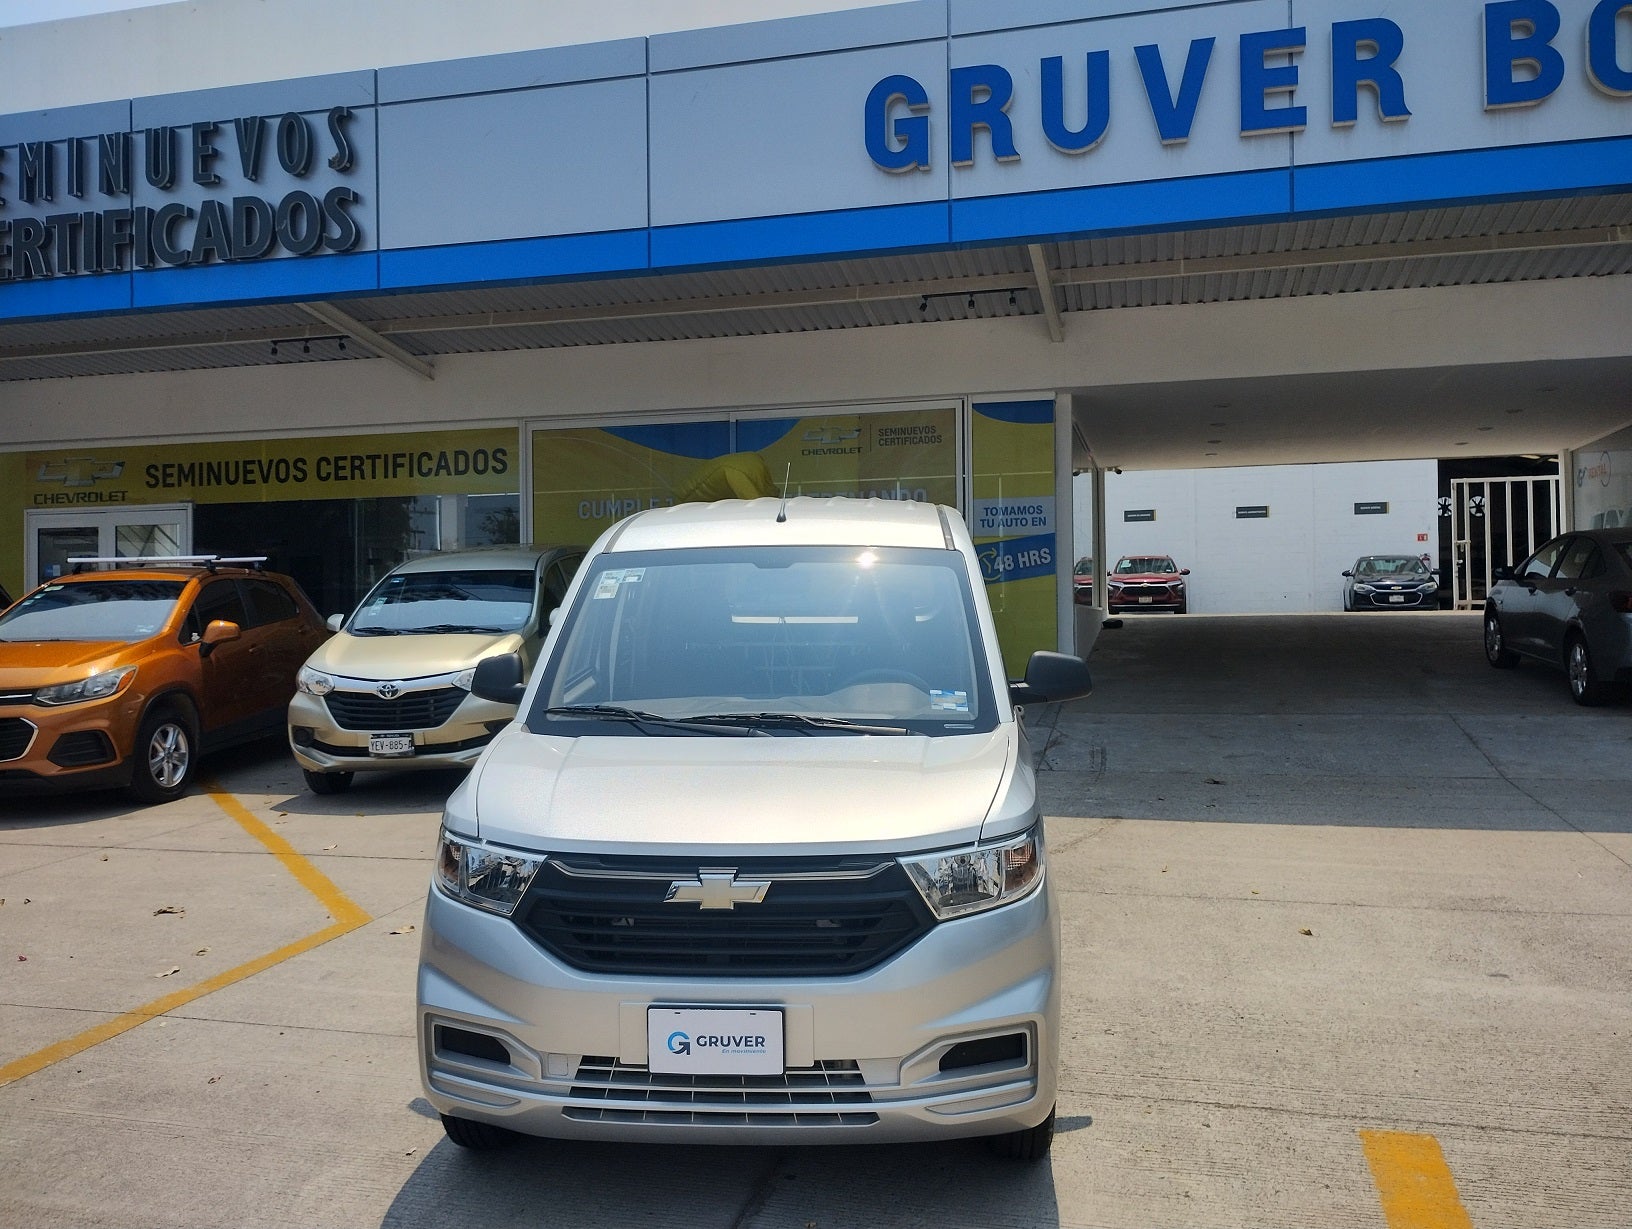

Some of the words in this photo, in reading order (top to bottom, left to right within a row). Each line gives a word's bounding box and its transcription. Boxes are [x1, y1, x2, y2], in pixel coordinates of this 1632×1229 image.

[864, 17, 1412, 174] GRUVER
[878, 425, 937, 437] SEMINUEVOS
[878, 434, 943, 447] CERTIFICADOS
[801, 446, 863, 456] CHEVROLET
[144, 457, 308, 489] SEMINUEVOS
[316, 447, 508, 482] CERTIFICADOS
[33, 490, 129, 505] CHEVROLET
[983, 505, 1043, 517] TOMAMOS
[980, 518, 994, 528] TU
[998, 517, 1028, 528] AUTO
[1031, 516, 1047, 527] EN
[994, 554, 1015, 572] 48
[1018, 547, 1051, 568] HRS
[696, 1035, 766, 1048] GRUVER
